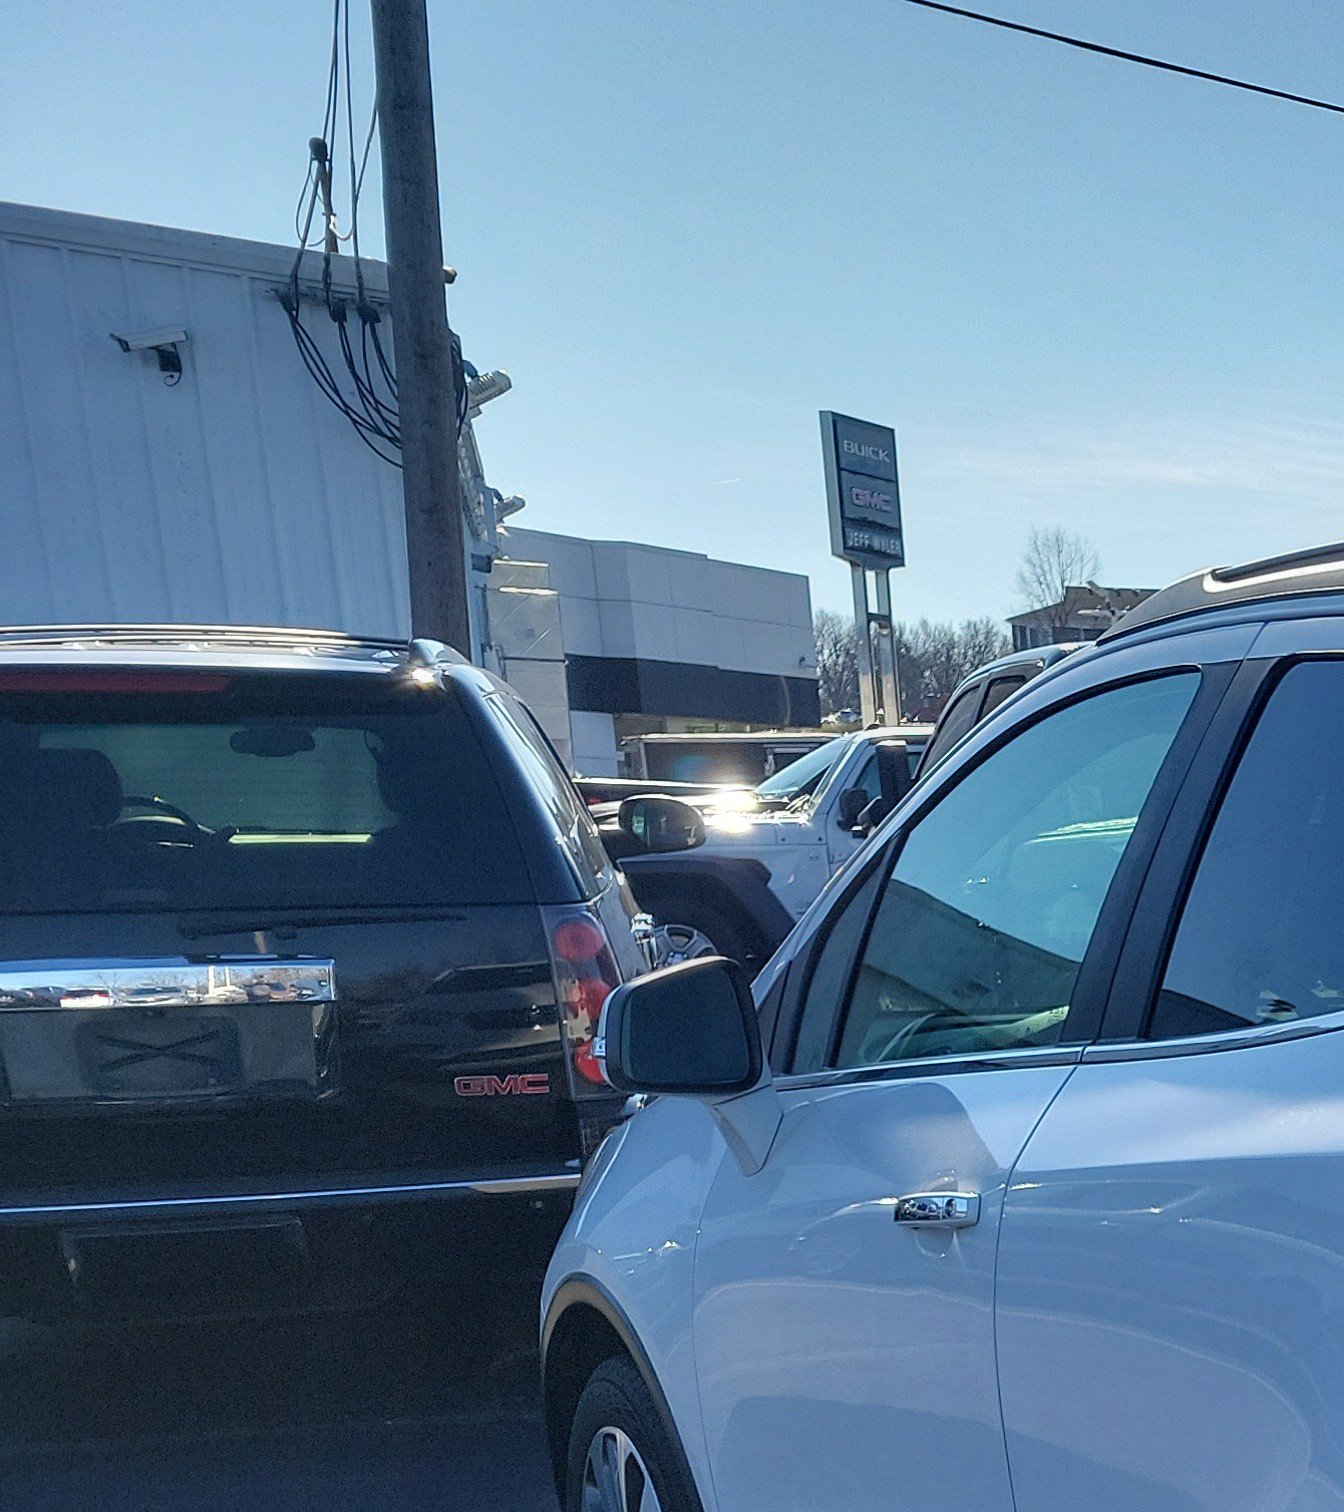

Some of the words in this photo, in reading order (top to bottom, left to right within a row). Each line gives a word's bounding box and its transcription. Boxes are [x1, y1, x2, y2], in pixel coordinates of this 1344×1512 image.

[843, 439, 890, 463] BUICK
[851, 487, 892, 513] GMC
[454, 1073, 550, 1097] GMC
